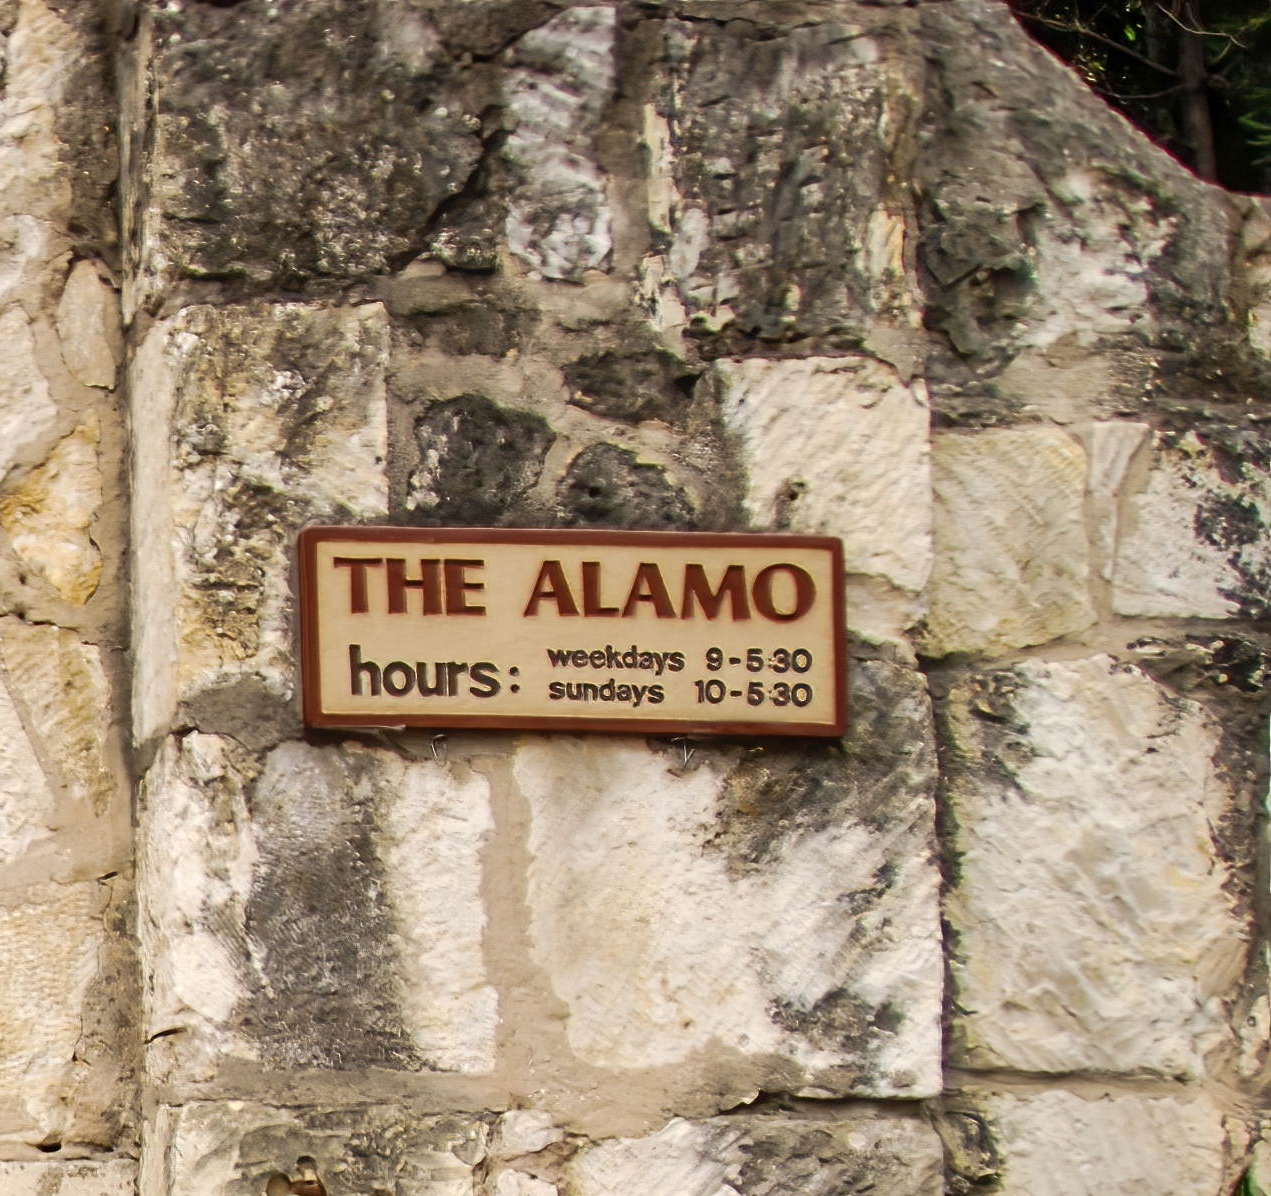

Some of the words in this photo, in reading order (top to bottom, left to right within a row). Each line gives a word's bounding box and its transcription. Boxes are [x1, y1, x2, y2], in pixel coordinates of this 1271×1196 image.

[334, 557, 486, 616] THE
[523, 560, 817, 623] ALAMO
[349, 645, 521, 698] hours:
[546, 644, 687, 677] weekdays
[548, 678, 667, 707] sundays
